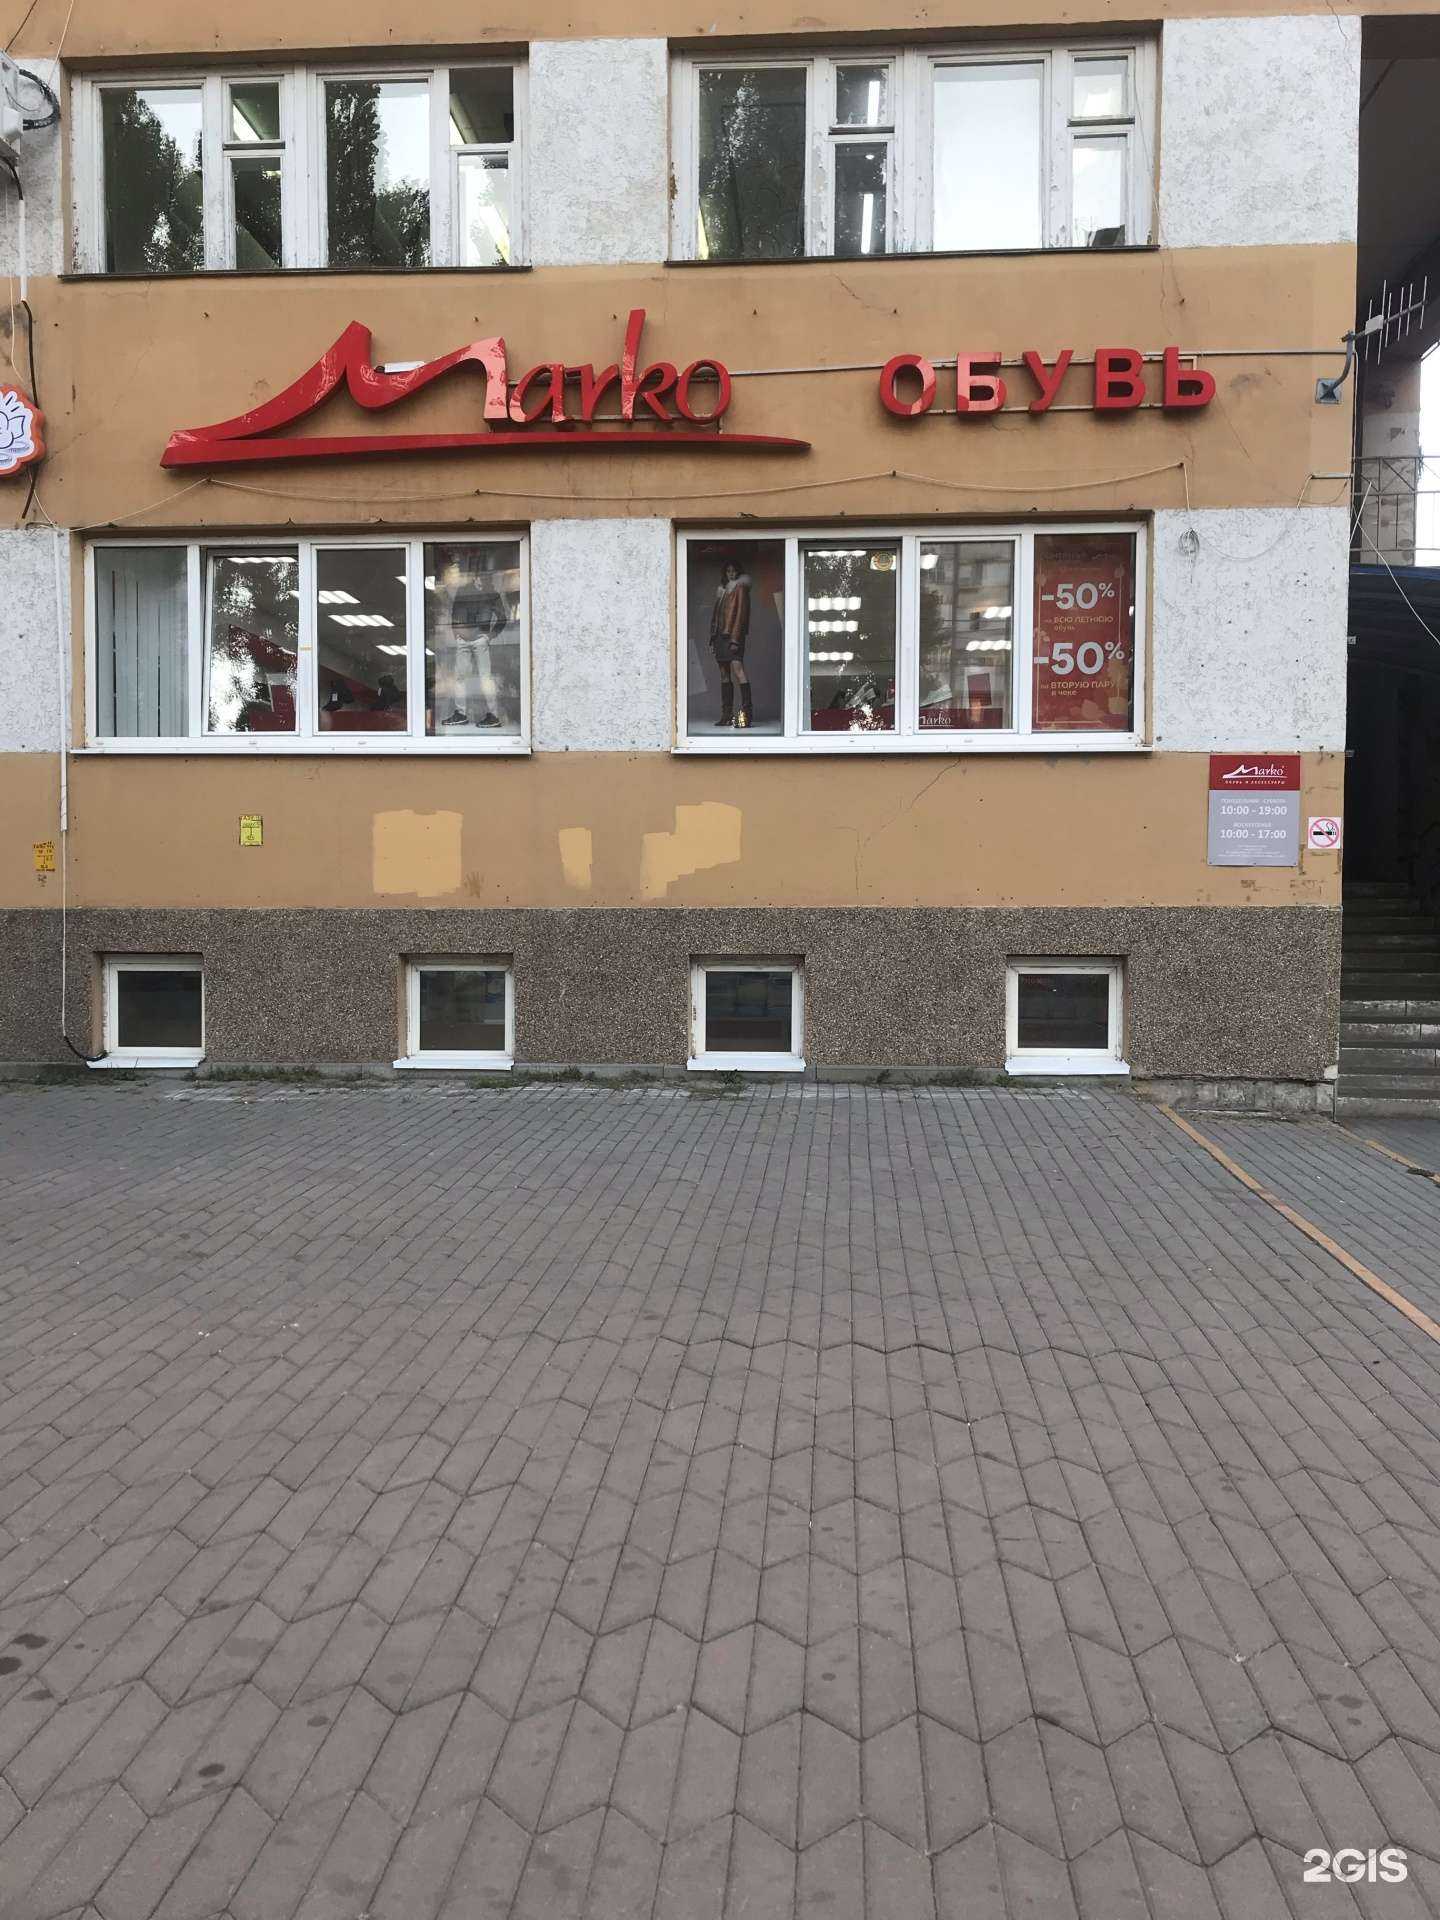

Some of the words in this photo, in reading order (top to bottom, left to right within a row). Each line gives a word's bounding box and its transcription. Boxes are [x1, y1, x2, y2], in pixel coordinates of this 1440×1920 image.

[161, 308, 734, 462] Marko
[879, 346, 1216, 417] ОБУВЬ
[1041, 582, 1115, 610] -50%
[1033, 641, 1125, 675] -50%
[1051, 681, 1090, 690] ВТОРУЮ
[1091, 681, 1115, 689] ПАРУ
[1222, 764, 1284, 779] Marko
[1220, 805, 1249, 815] 10:00
[1259, 806, 1287, 815] 19:00
[1220, 829, 1249, 839] 10:00
[1258, 829, 1287, 839] 17:00
